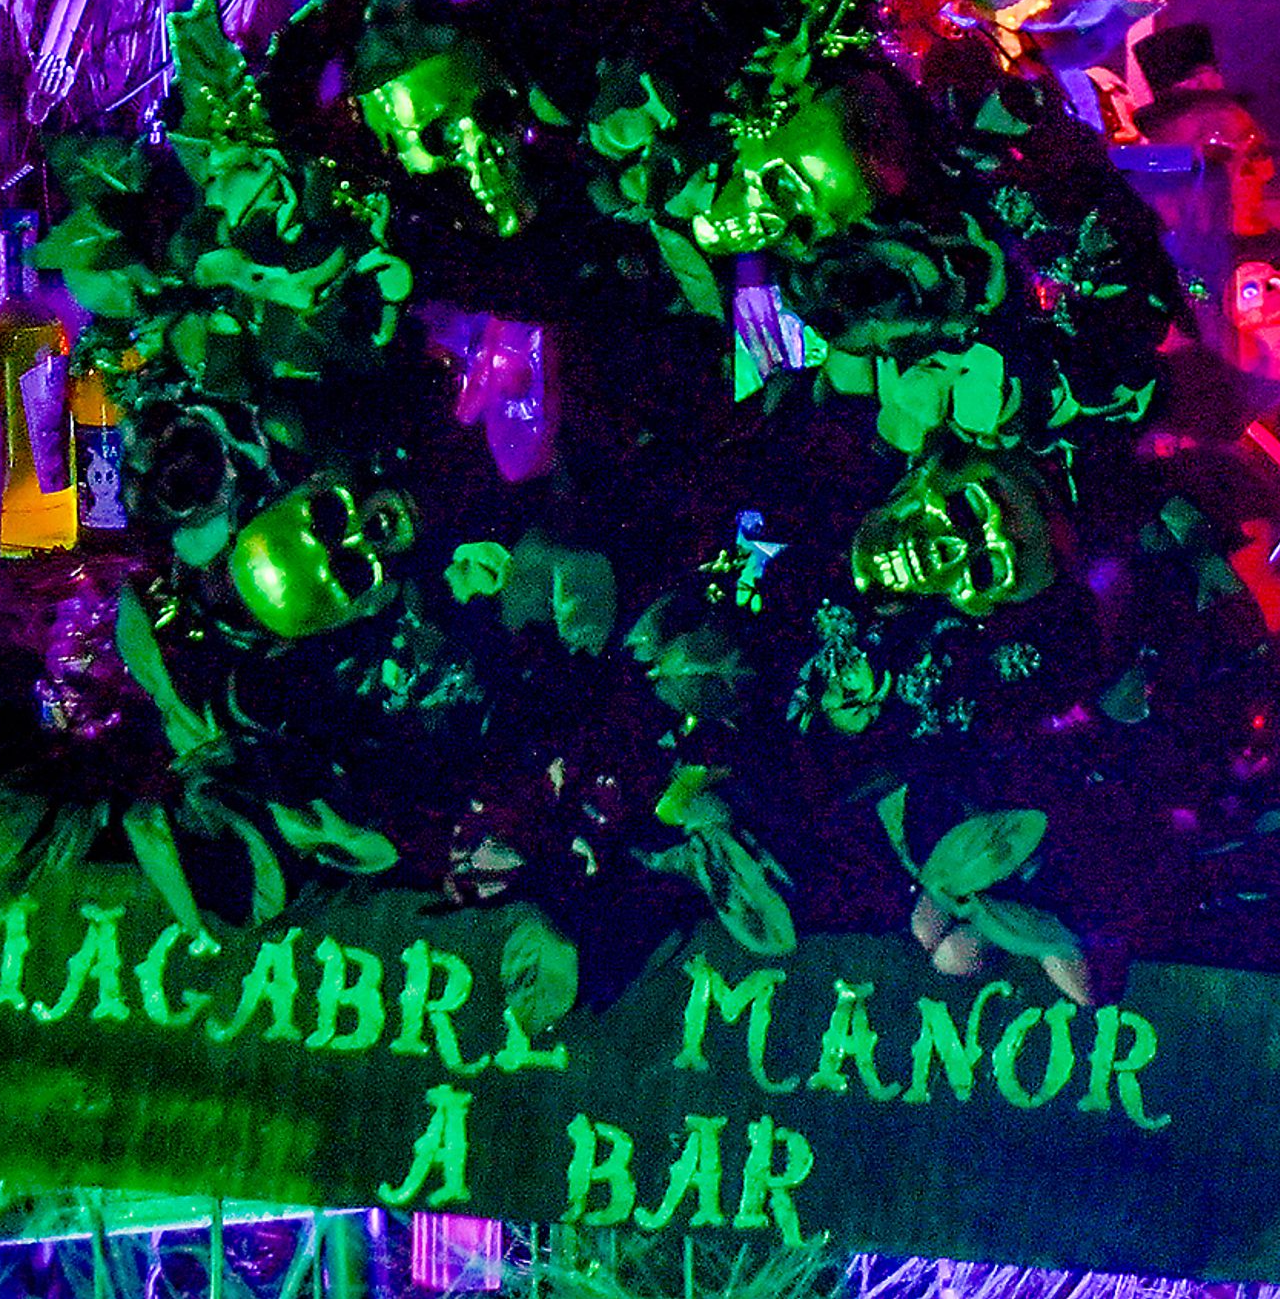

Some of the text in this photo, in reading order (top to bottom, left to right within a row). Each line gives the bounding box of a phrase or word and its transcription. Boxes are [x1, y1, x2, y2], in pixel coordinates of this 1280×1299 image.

[672, 952, 1172, 1131] MANOR
[377, 1084, 826, 1248] A BAR
